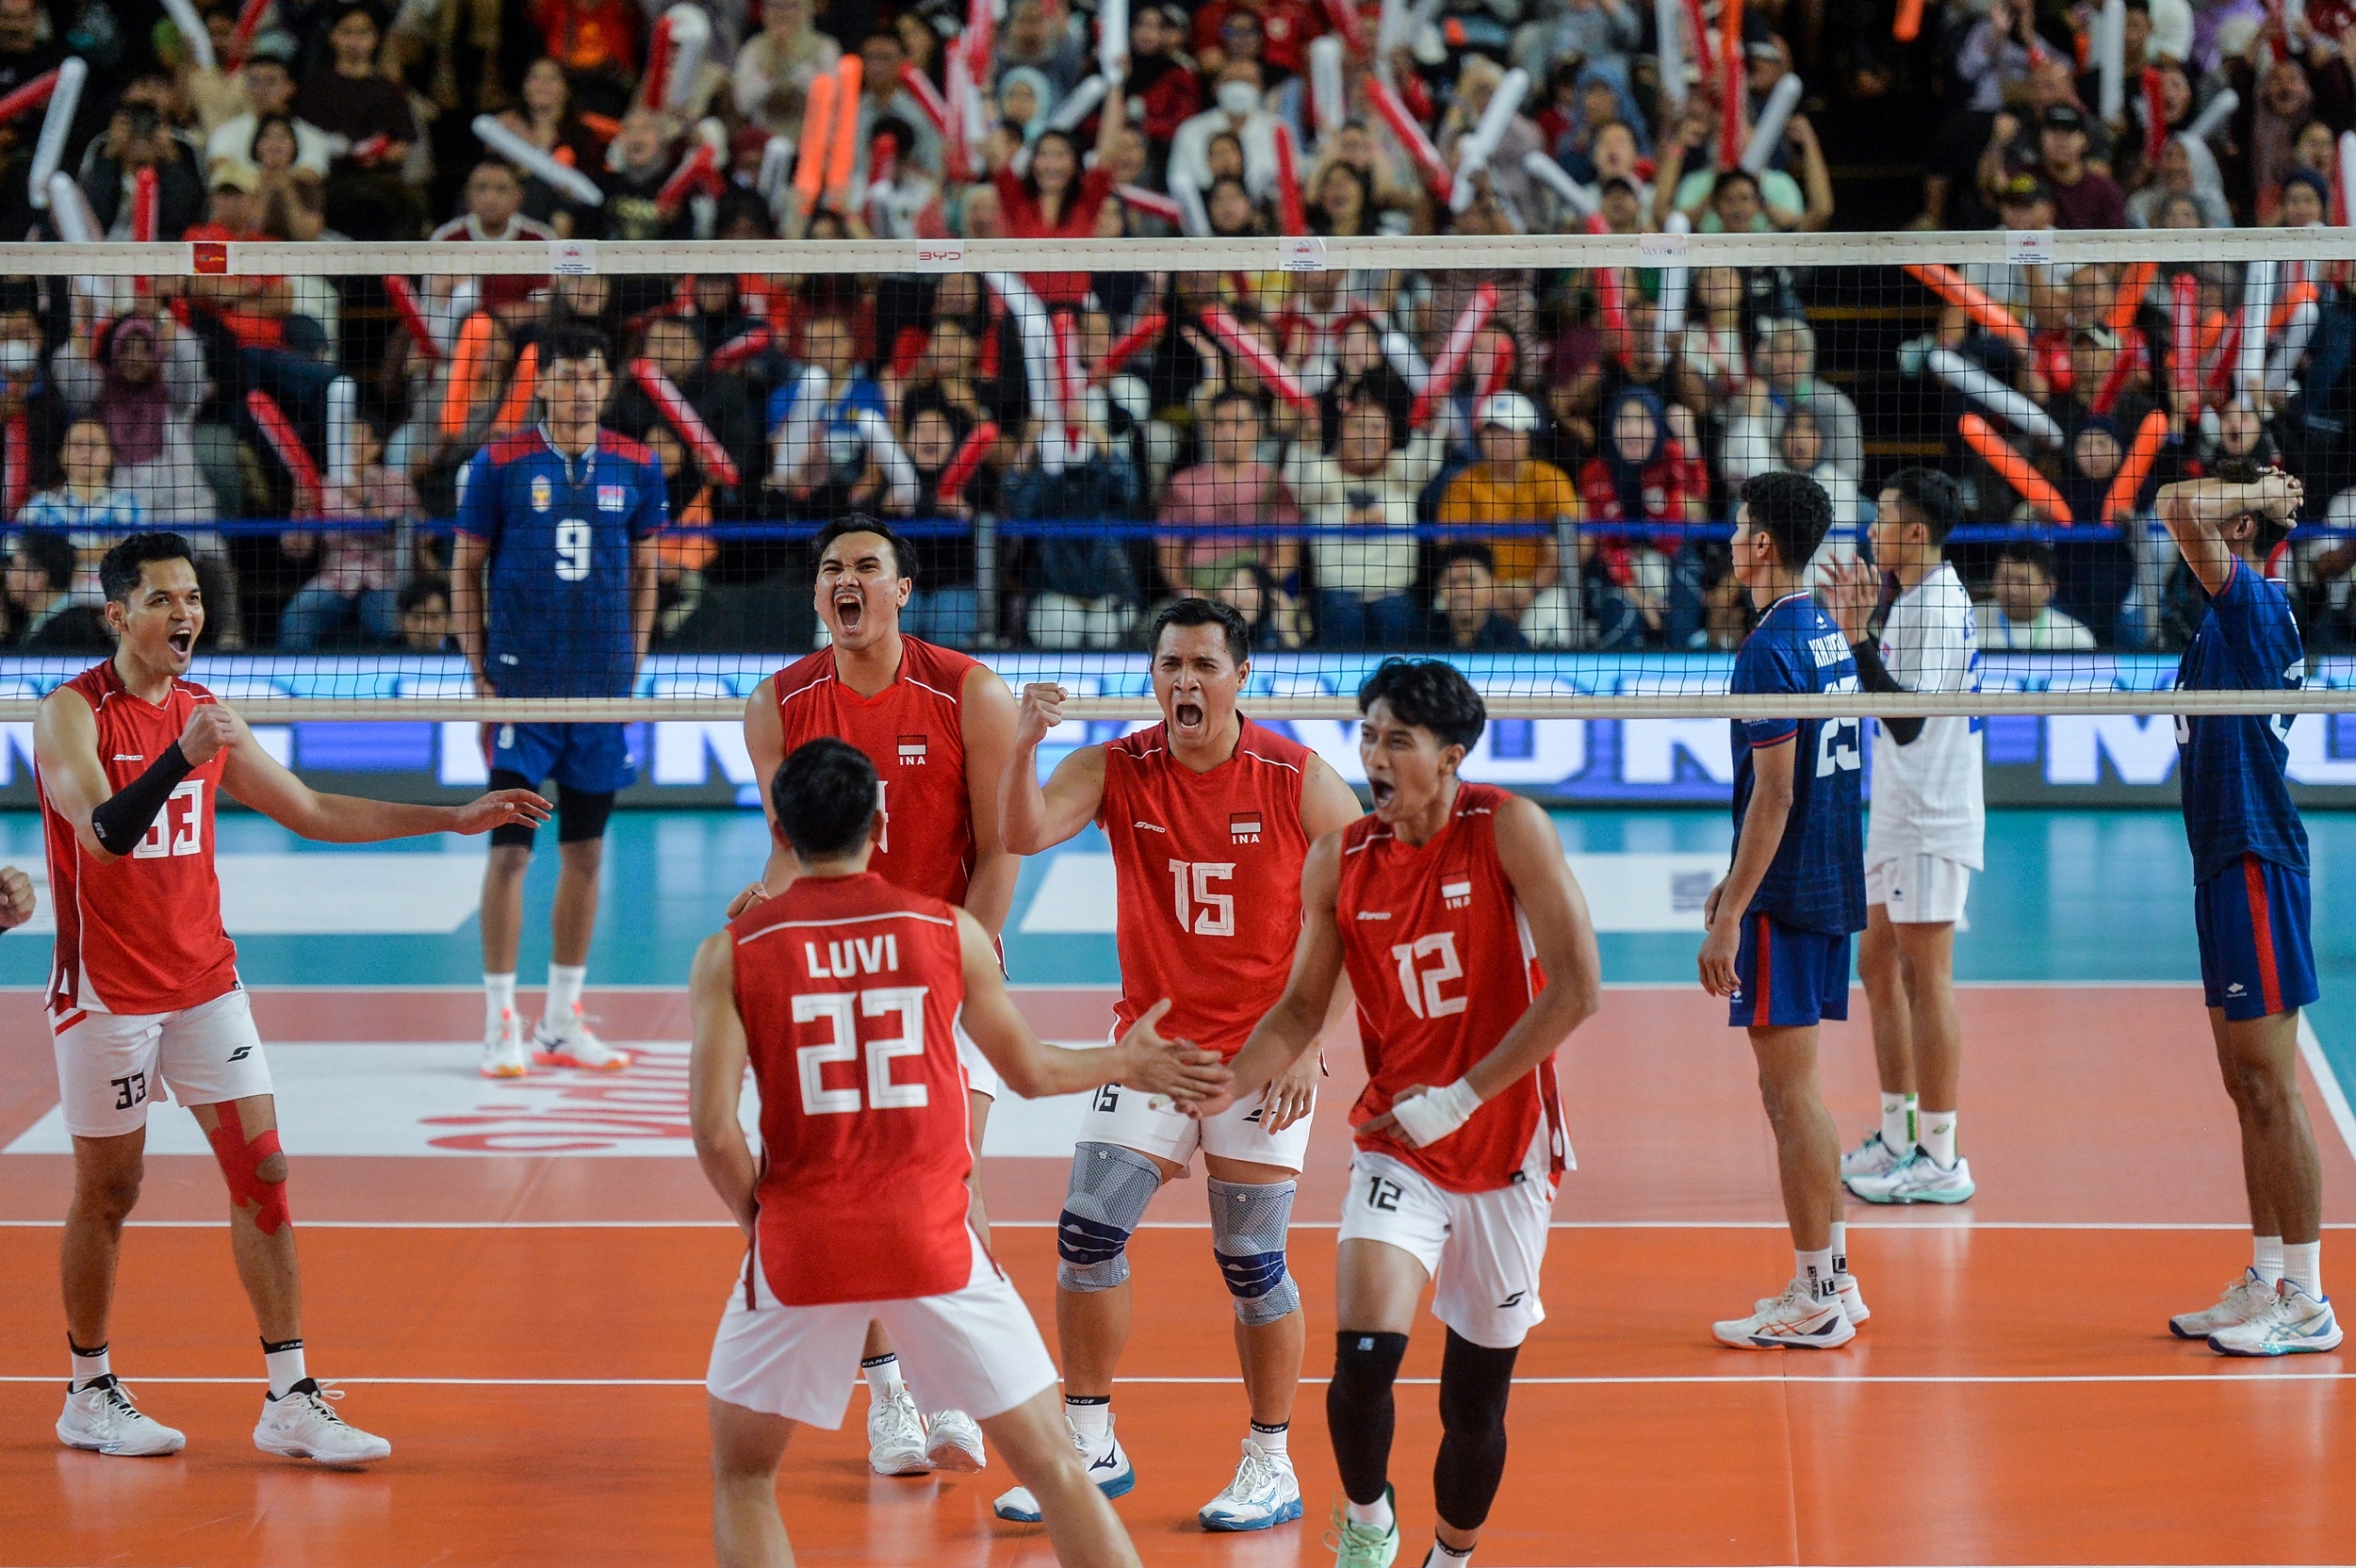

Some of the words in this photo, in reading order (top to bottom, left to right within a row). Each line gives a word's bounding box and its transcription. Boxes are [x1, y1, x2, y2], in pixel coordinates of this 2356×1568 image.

[919, 252, 961, 260] BYD
[554, 518, 592, 581] 9
[899, 756, 925, 766] INA
[1232, 833, 1260, 845] INA
[1169, 858, 1236, 937] 15
[804, 934, 899, 979] LUVI
[1391, 931, 1468, 1020] 12
[791, 986, 930, 1117] 22
[110, 1070, 147, 1111] 33
[1092, 1082, 1122, 1114] 15
[1368, 1176, 1402, 1213] 12
